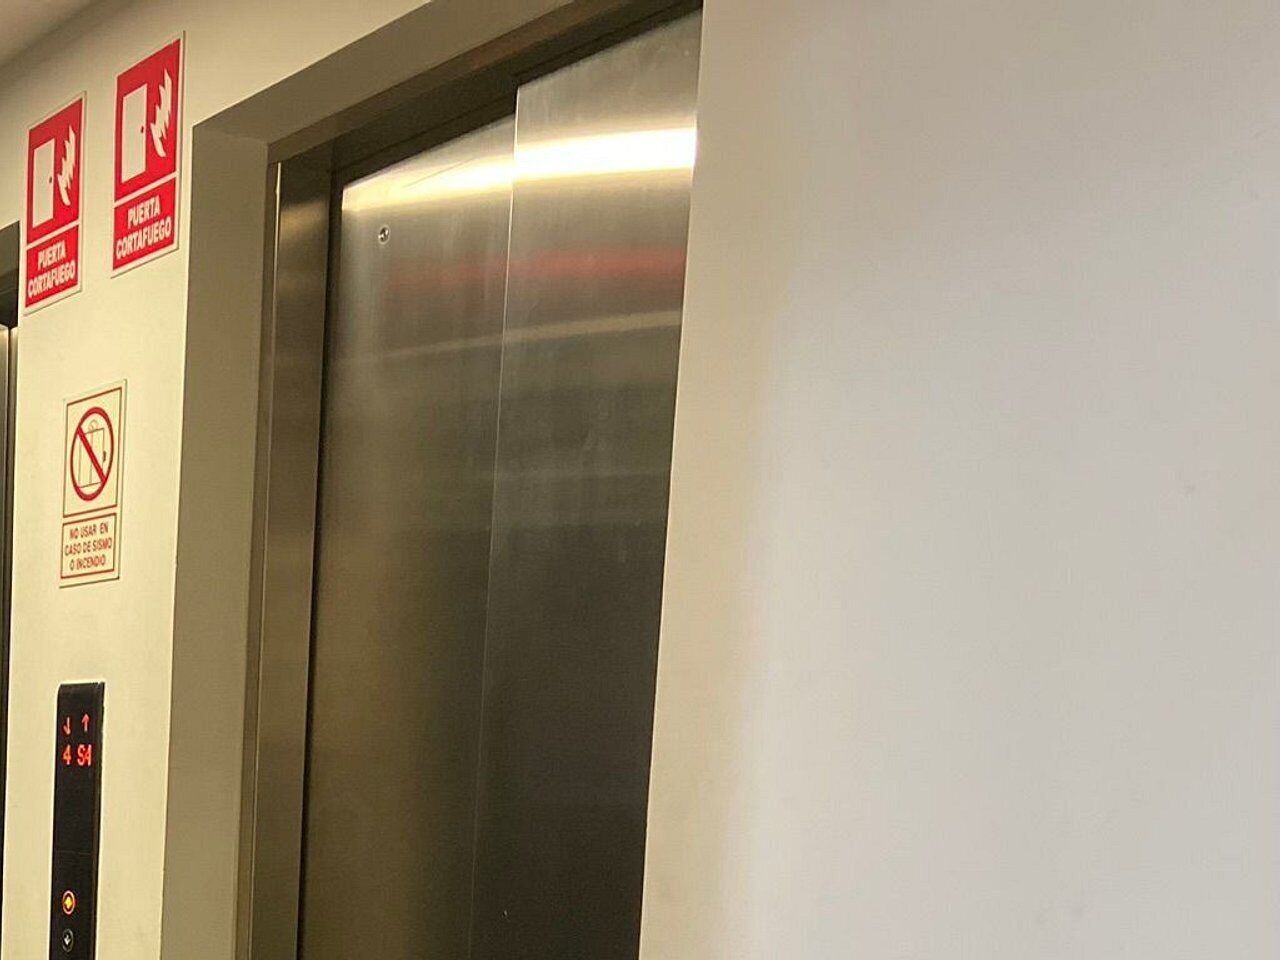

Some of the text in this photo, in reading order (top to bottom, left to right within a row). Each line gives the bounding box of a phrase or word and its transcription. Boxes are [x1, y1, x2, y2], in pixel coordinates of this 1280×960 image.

[127, 194, 161, 230] PUERTA
[116, 216, 172, 260] CORTAFUEGO
[37, 240, 66, 271] PUERTA
[28, 259, 76, 298] CORTAFUEGO
[70, 522, 109, 540] NO USAR EN
[64, 537, 113, 557] CASO DE SISMO
[69, 554, 107, 571] O INCENDIO
[63, 744, 72, 766] 4
